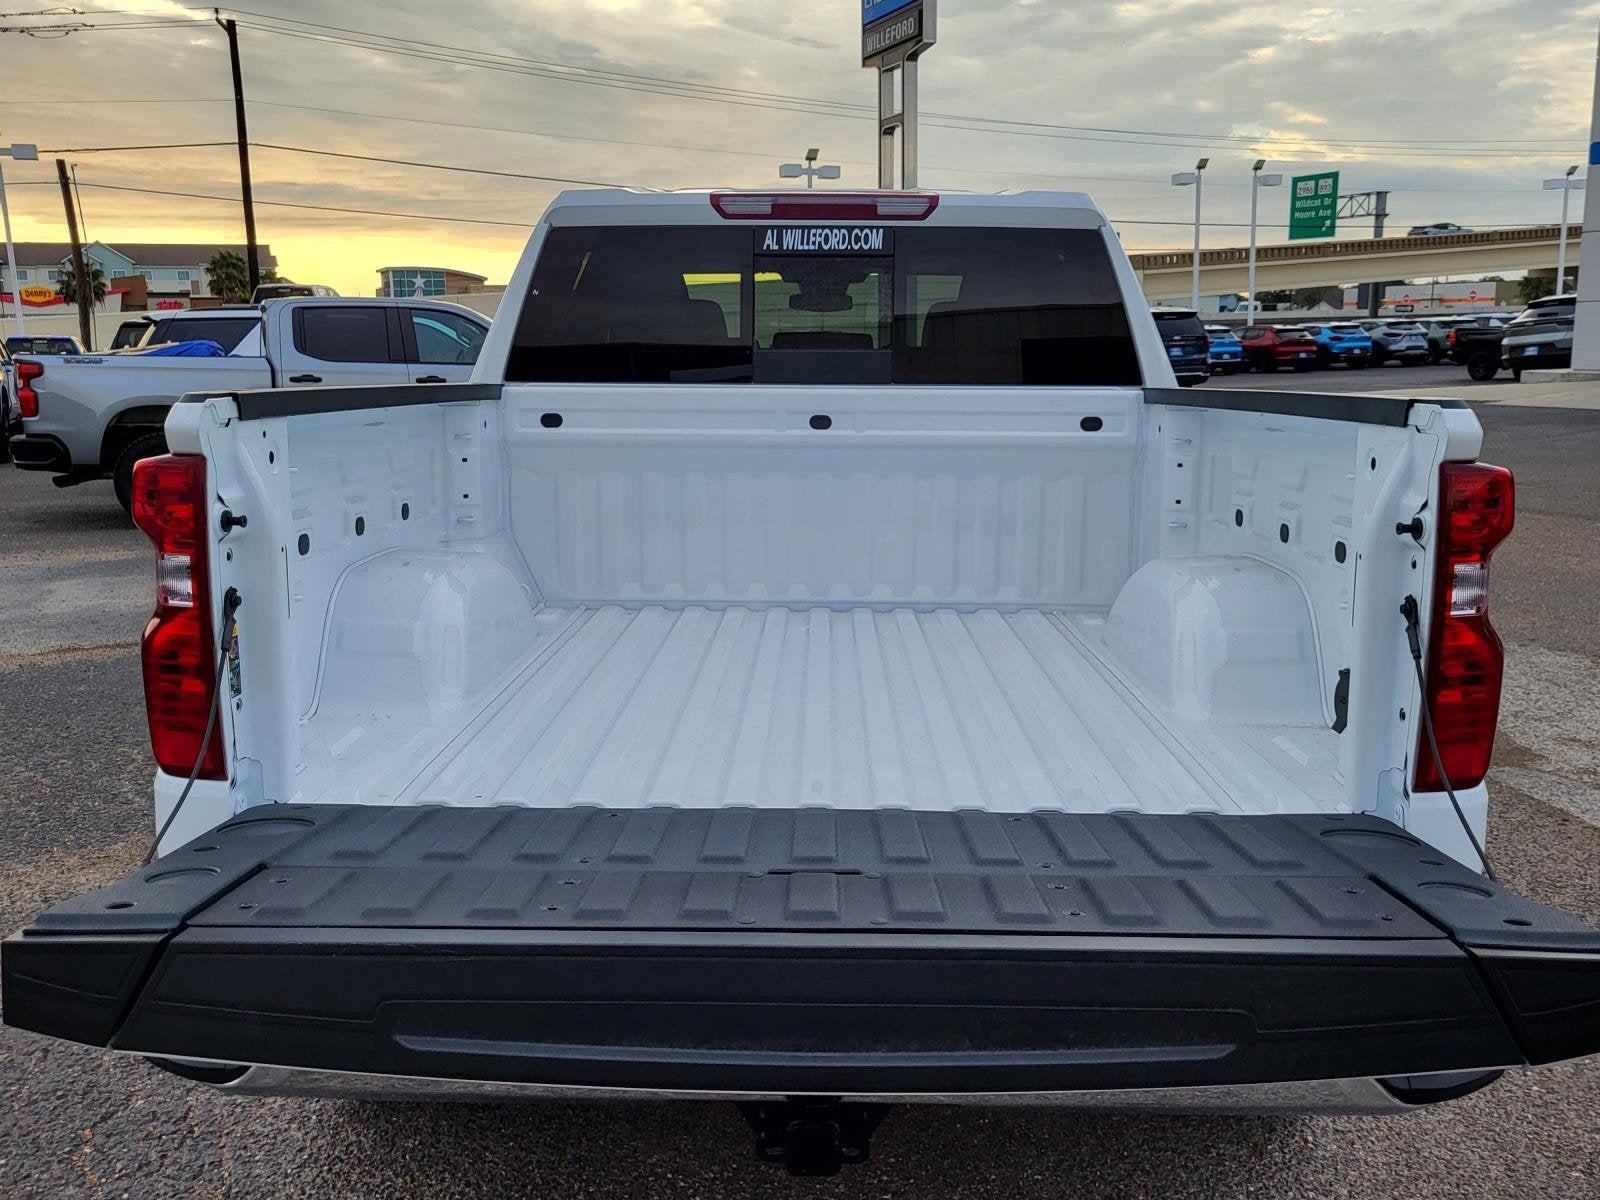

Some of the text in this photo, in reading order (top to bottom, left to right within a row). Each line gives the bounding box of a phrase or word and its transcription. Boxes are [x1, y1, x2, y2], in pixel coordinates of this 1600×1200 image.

[866, 17, 914, 52] WILLEFORD
[1296, 197, 1332, 208] Wildcat Dr
[1294, 209, 1332, 219] Moore Ave
[763, 228, 883, 250] AL WILLEFORD.COM
[25, 289, 52, 299] Denny's
